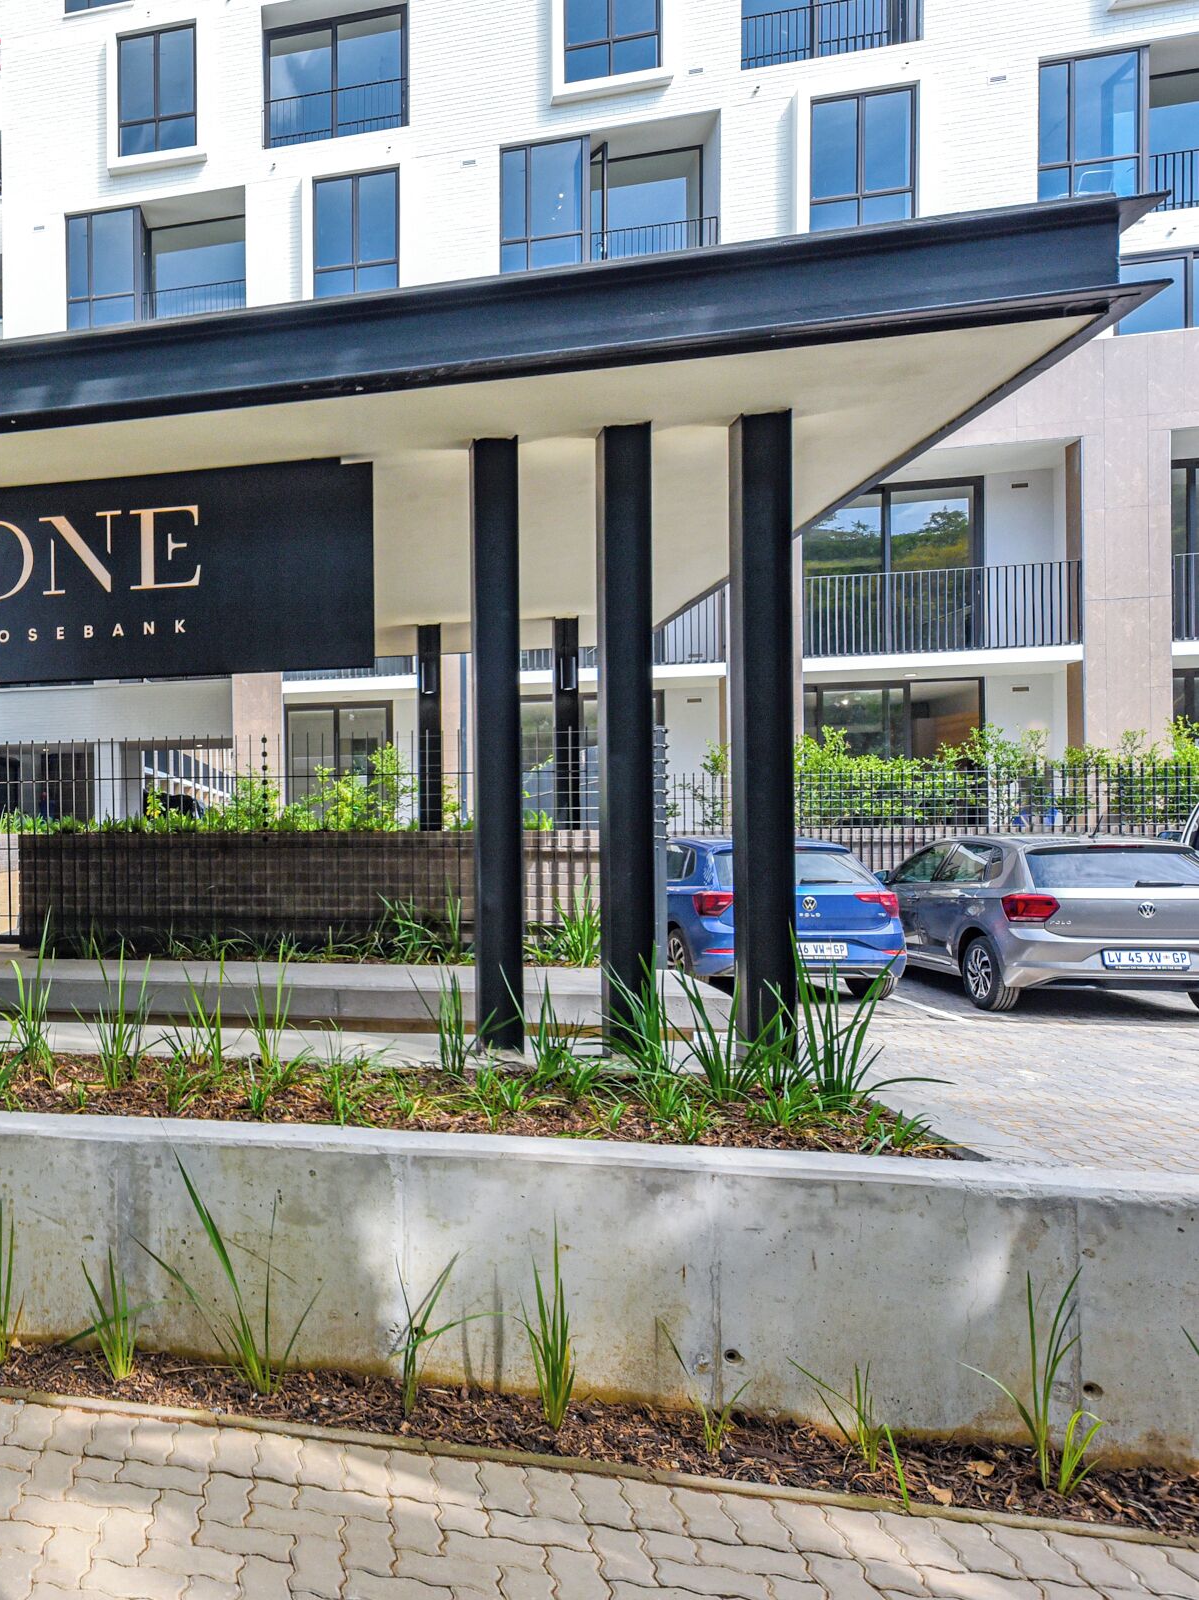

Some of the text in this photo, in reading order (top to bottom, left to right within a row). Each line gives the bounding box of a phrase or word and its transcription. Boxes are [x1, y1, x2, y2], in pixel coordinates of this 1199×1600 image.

[833, 944, 845, 954] GP
[1107, 952, 1187, 964] LV 45 XV GP
